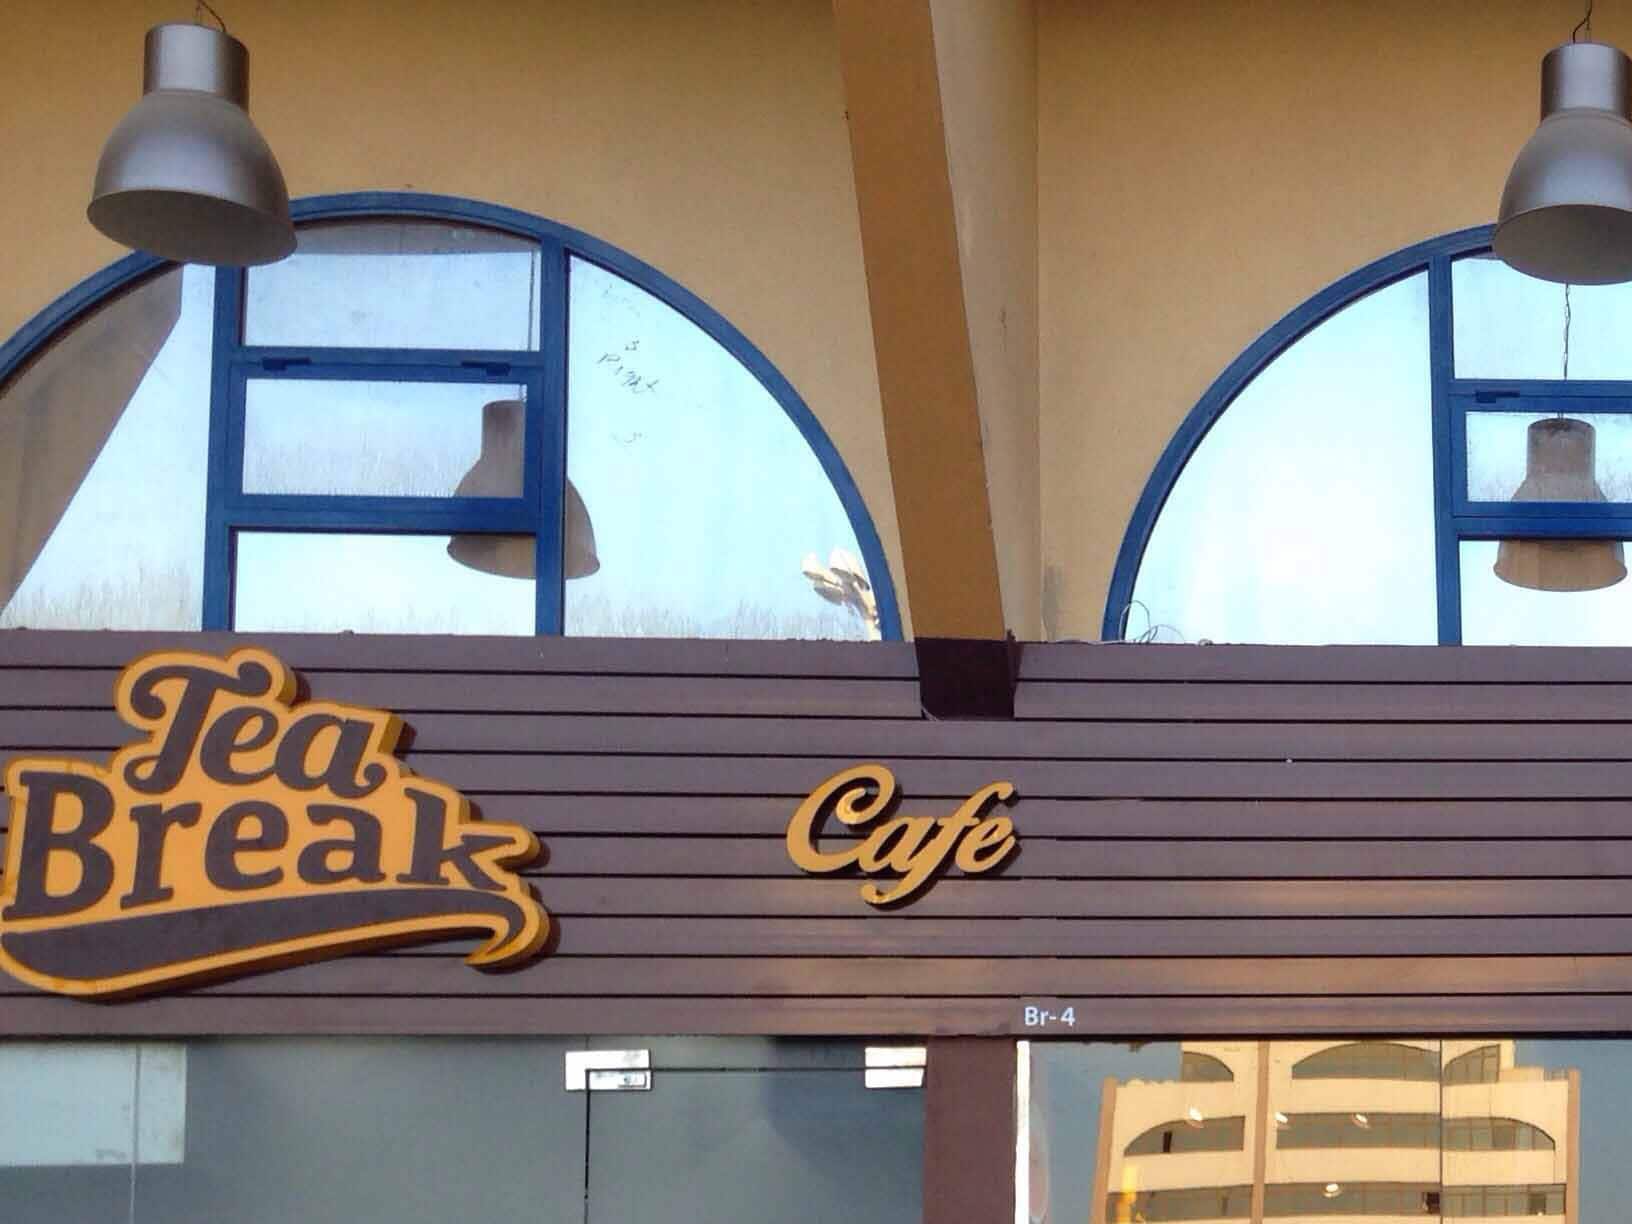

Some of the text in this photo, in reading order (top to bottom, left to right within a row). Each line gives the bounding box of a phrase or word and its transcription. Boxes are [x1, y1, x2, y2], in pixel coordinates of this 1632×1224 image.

[130, 656, 386, 796] Tea
[12, 768, 522, 920] Break
[786, 764, 1020, 908] Cafe
